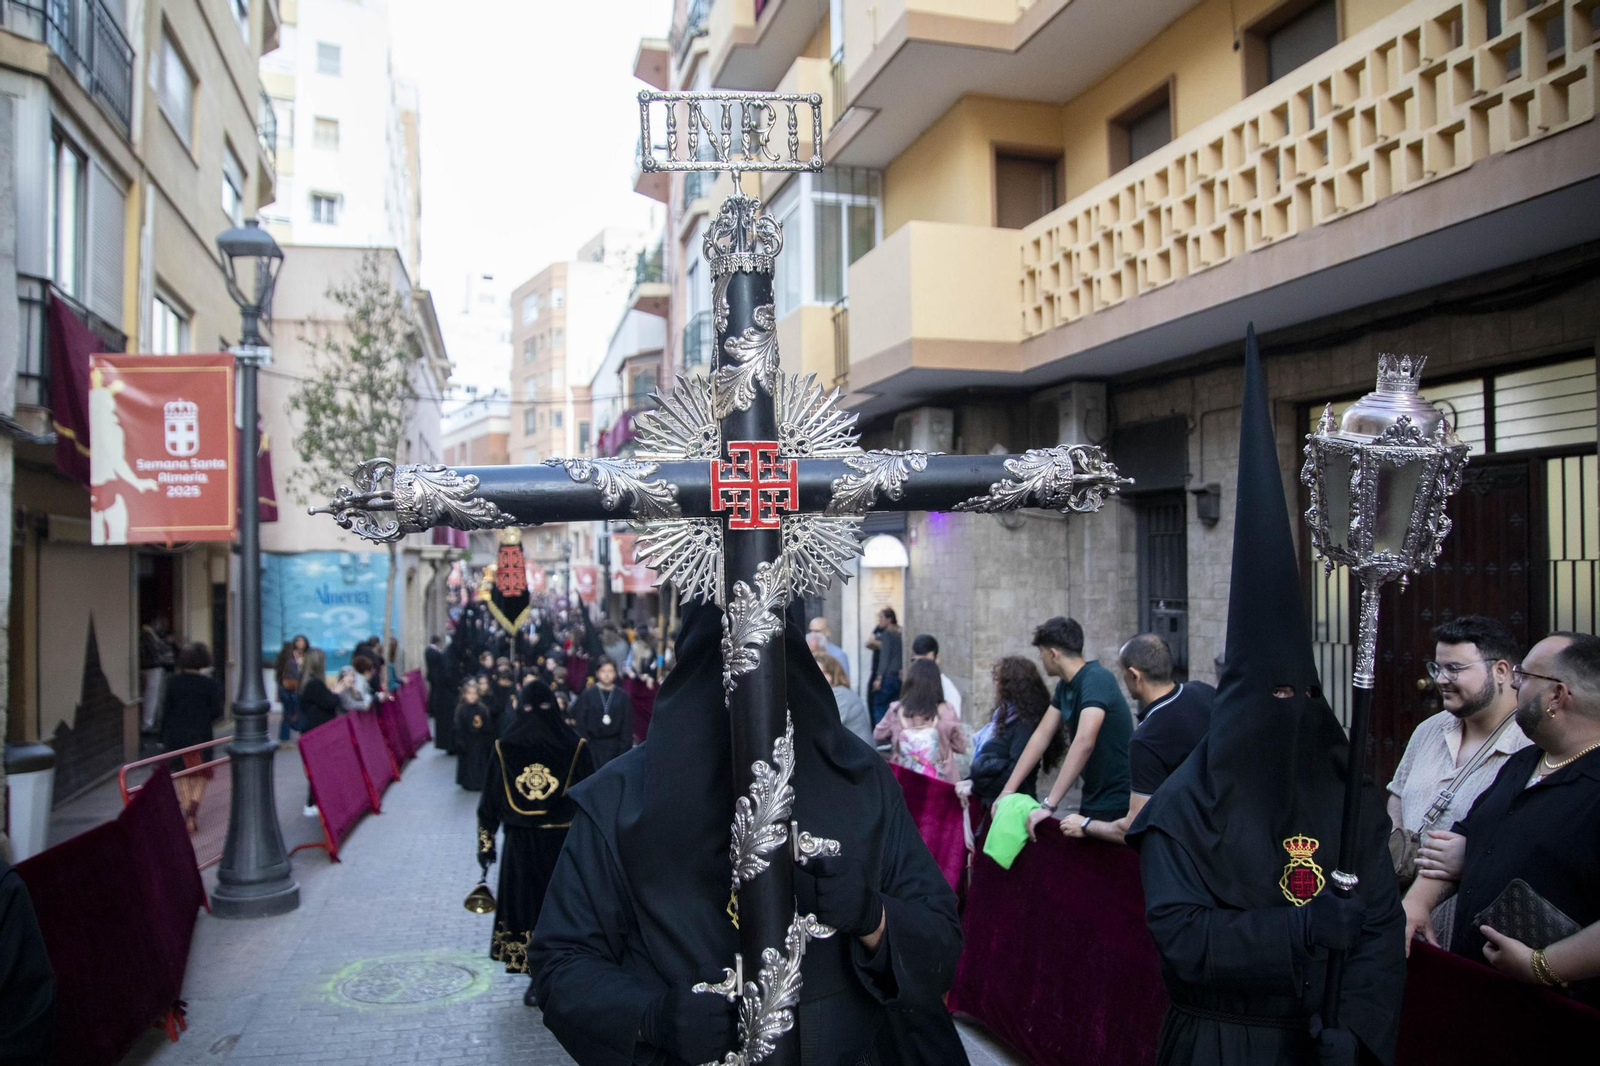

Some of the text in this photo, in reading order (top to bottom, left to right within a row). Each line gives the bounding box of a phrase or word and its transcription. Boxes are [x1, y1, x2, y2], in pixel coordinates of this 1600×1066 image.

[665, 100, 799, 163] INRI
[136, 458, 227, 471] Semana Santa
[166, 485, 201, 498] 2025
